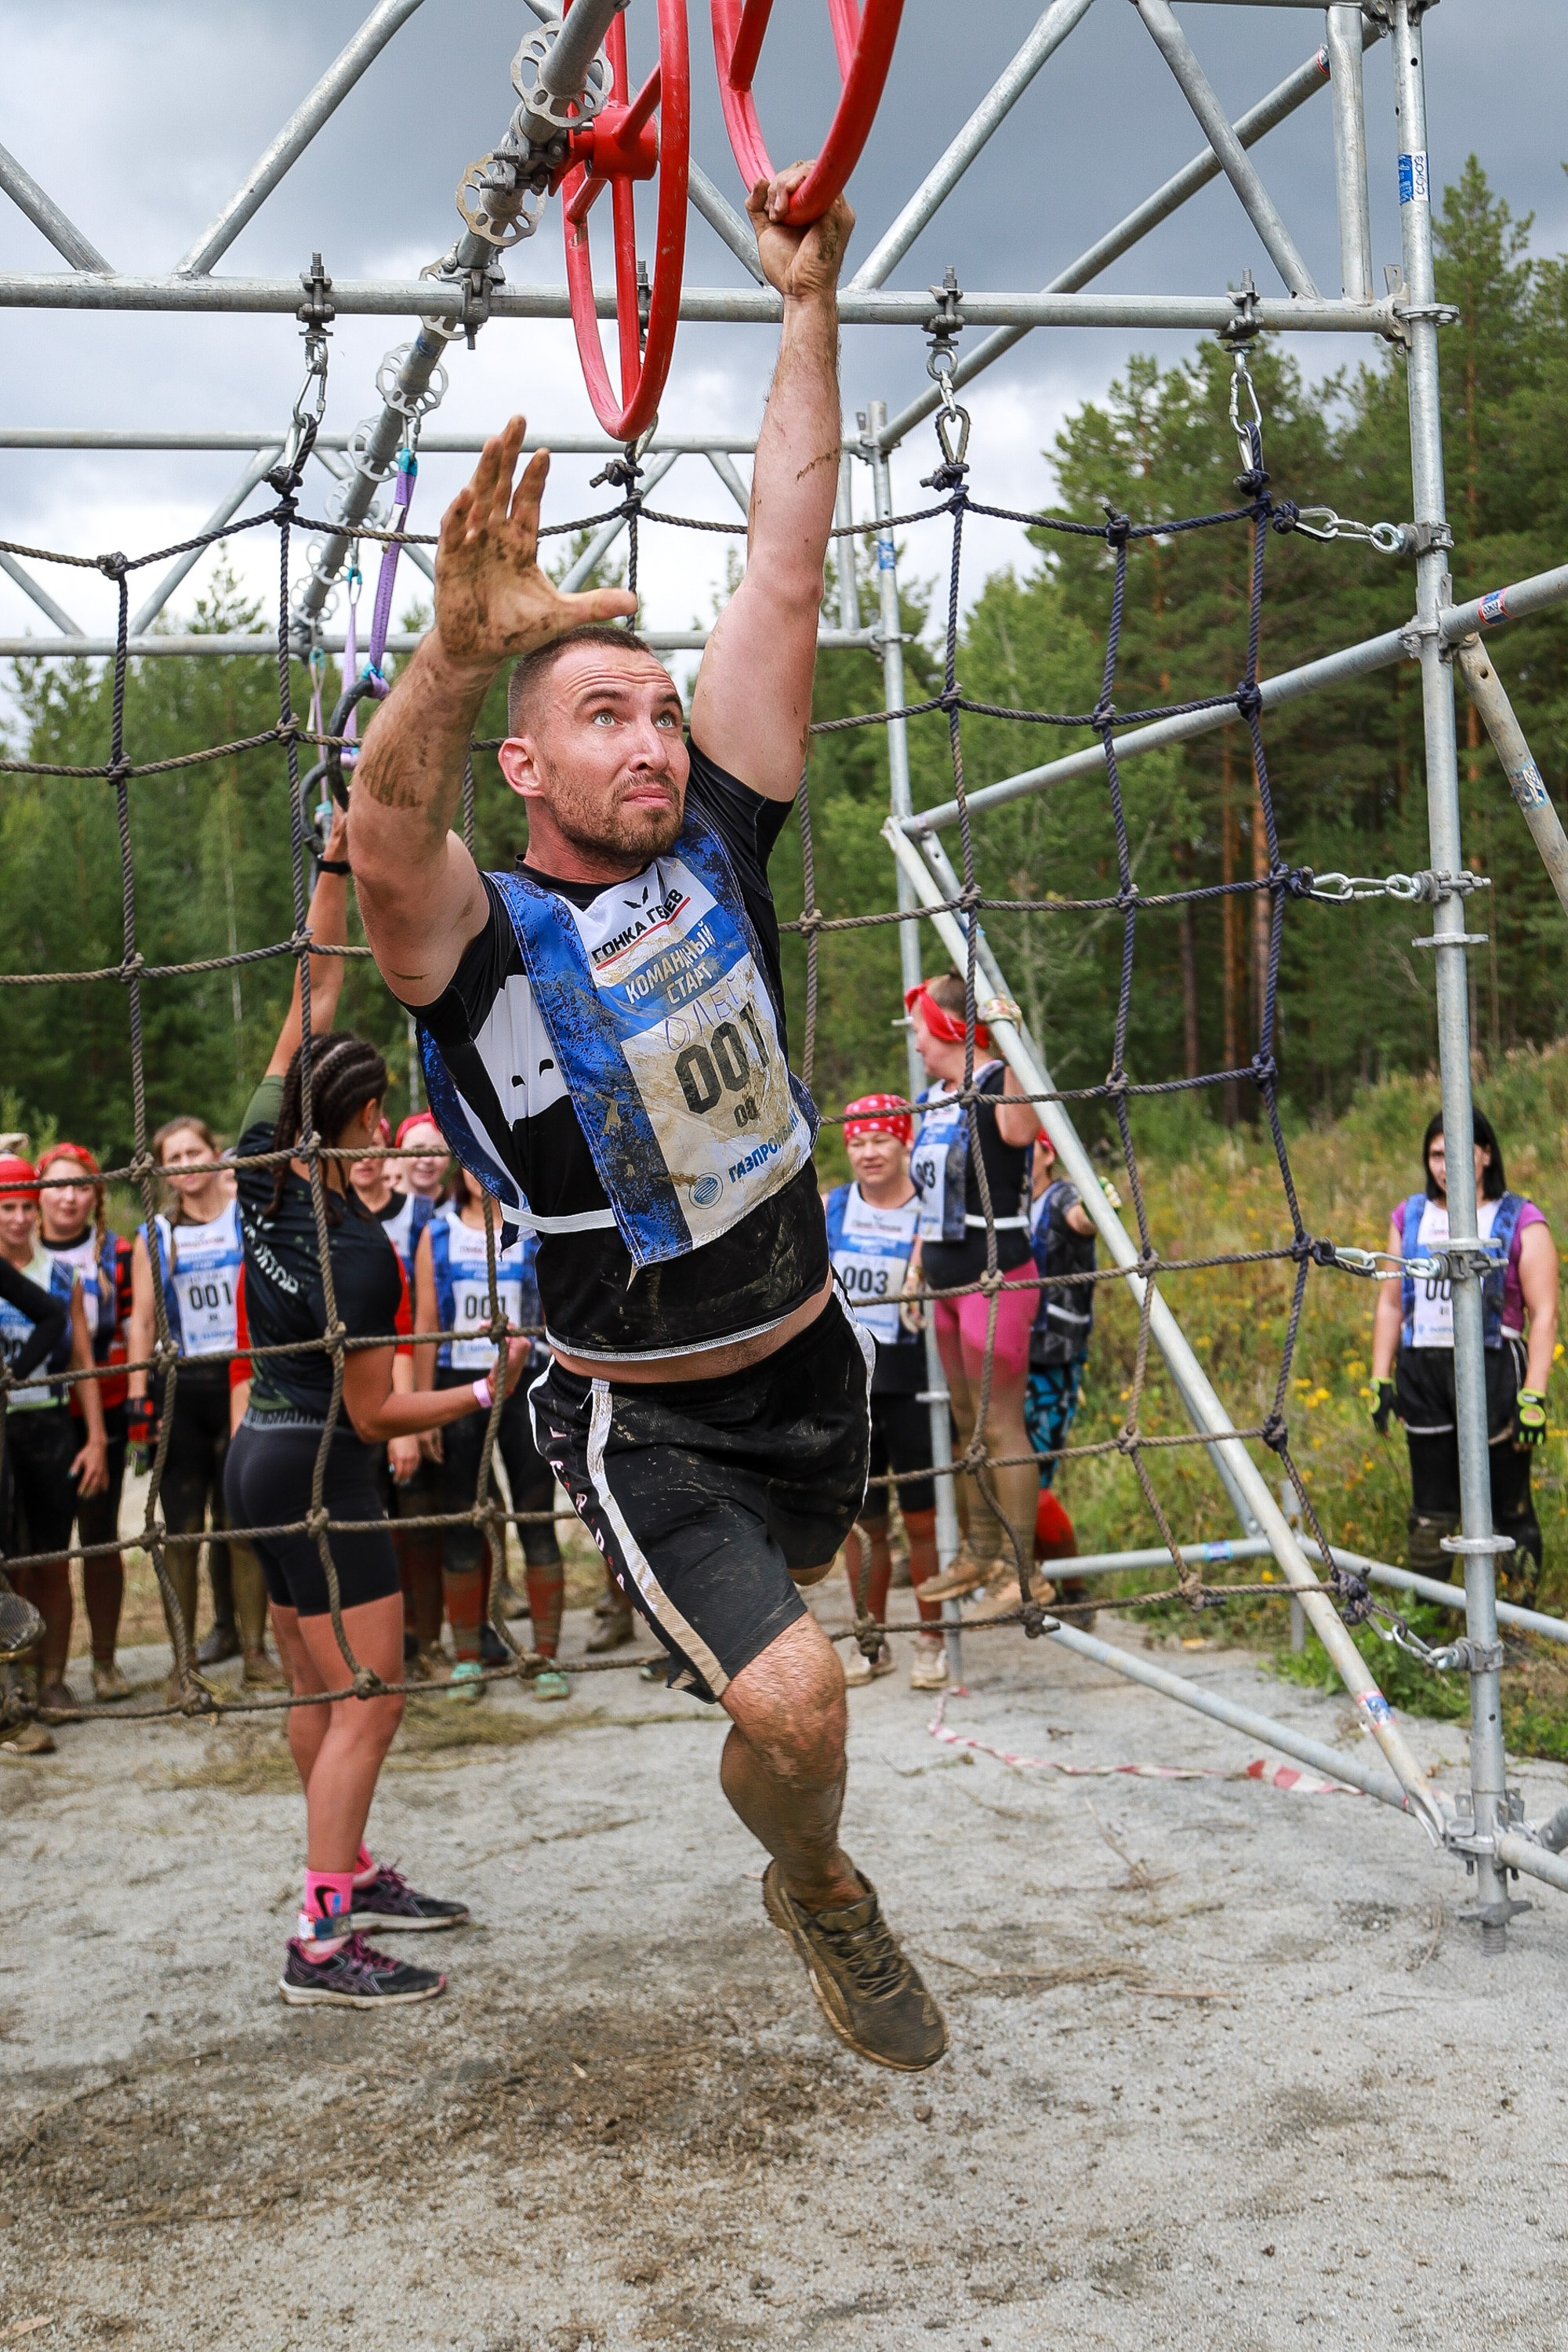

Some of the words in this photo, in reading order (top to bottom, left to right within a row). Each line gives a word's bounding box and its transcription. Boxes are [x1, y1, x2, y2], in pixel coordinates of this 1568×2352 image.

[591, 920, 648, 964] ГОНКА
[646, 888, 684, 924] ГЕЕВ
[665, 974, 739, 1050] ОЛЕГ
[666, 961, 713, 1005] СТАРТ
[674, 1001, 770, 1115] 001
[189, 1281, 232, 1310] 001
[843, 1265, 888, 1294] 003
